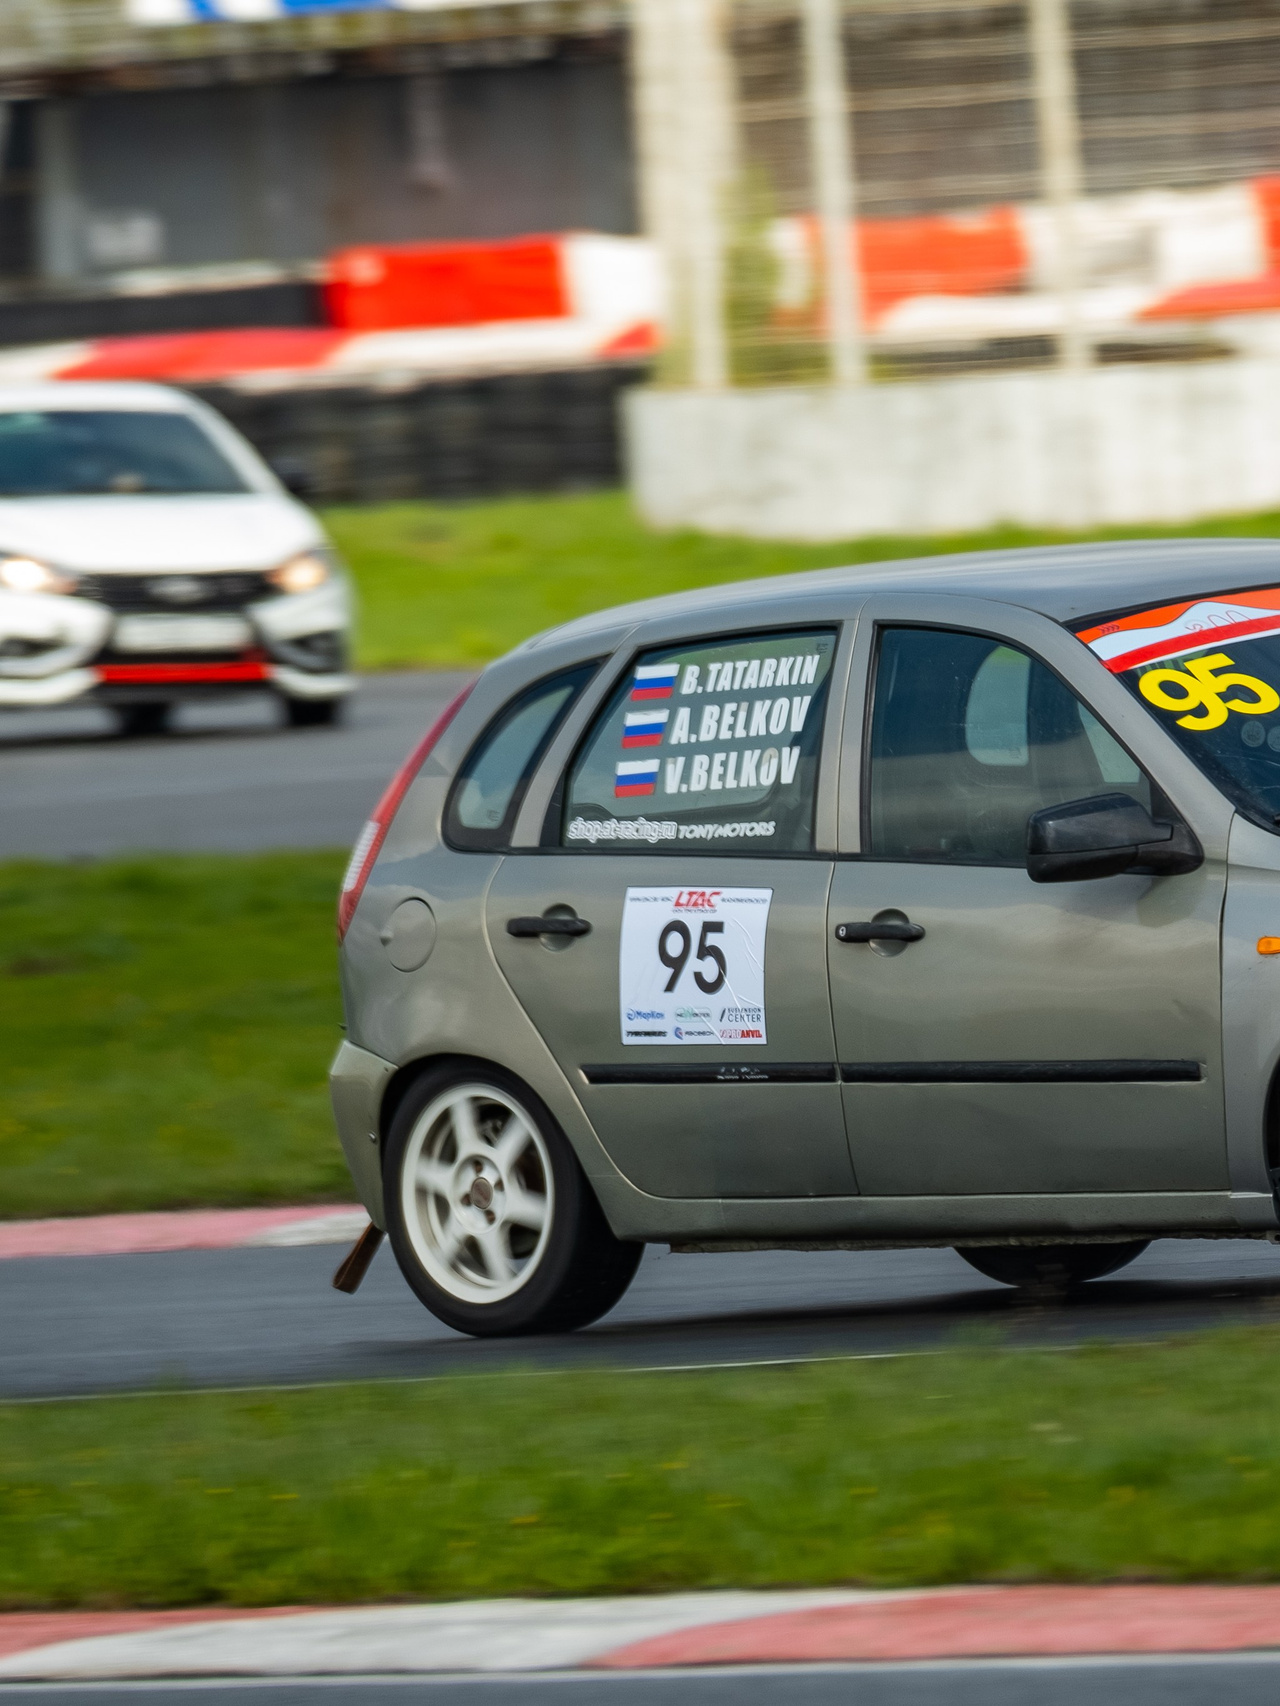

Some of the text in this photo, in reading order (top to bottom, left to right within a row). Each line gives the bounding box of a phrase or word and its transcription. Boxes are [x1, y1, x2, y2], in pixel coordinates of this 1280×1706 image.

[681, 654, 820, 695] B.TATARKIN
[1138, 652, 1280, 731] 95
[669, 695, 812, 745] A.BELKOV
[664, 746, 801, 794] V.BELKOV
[658, 919, 728, 995] 95
[727, 1014, 762, 1022] CENTER
